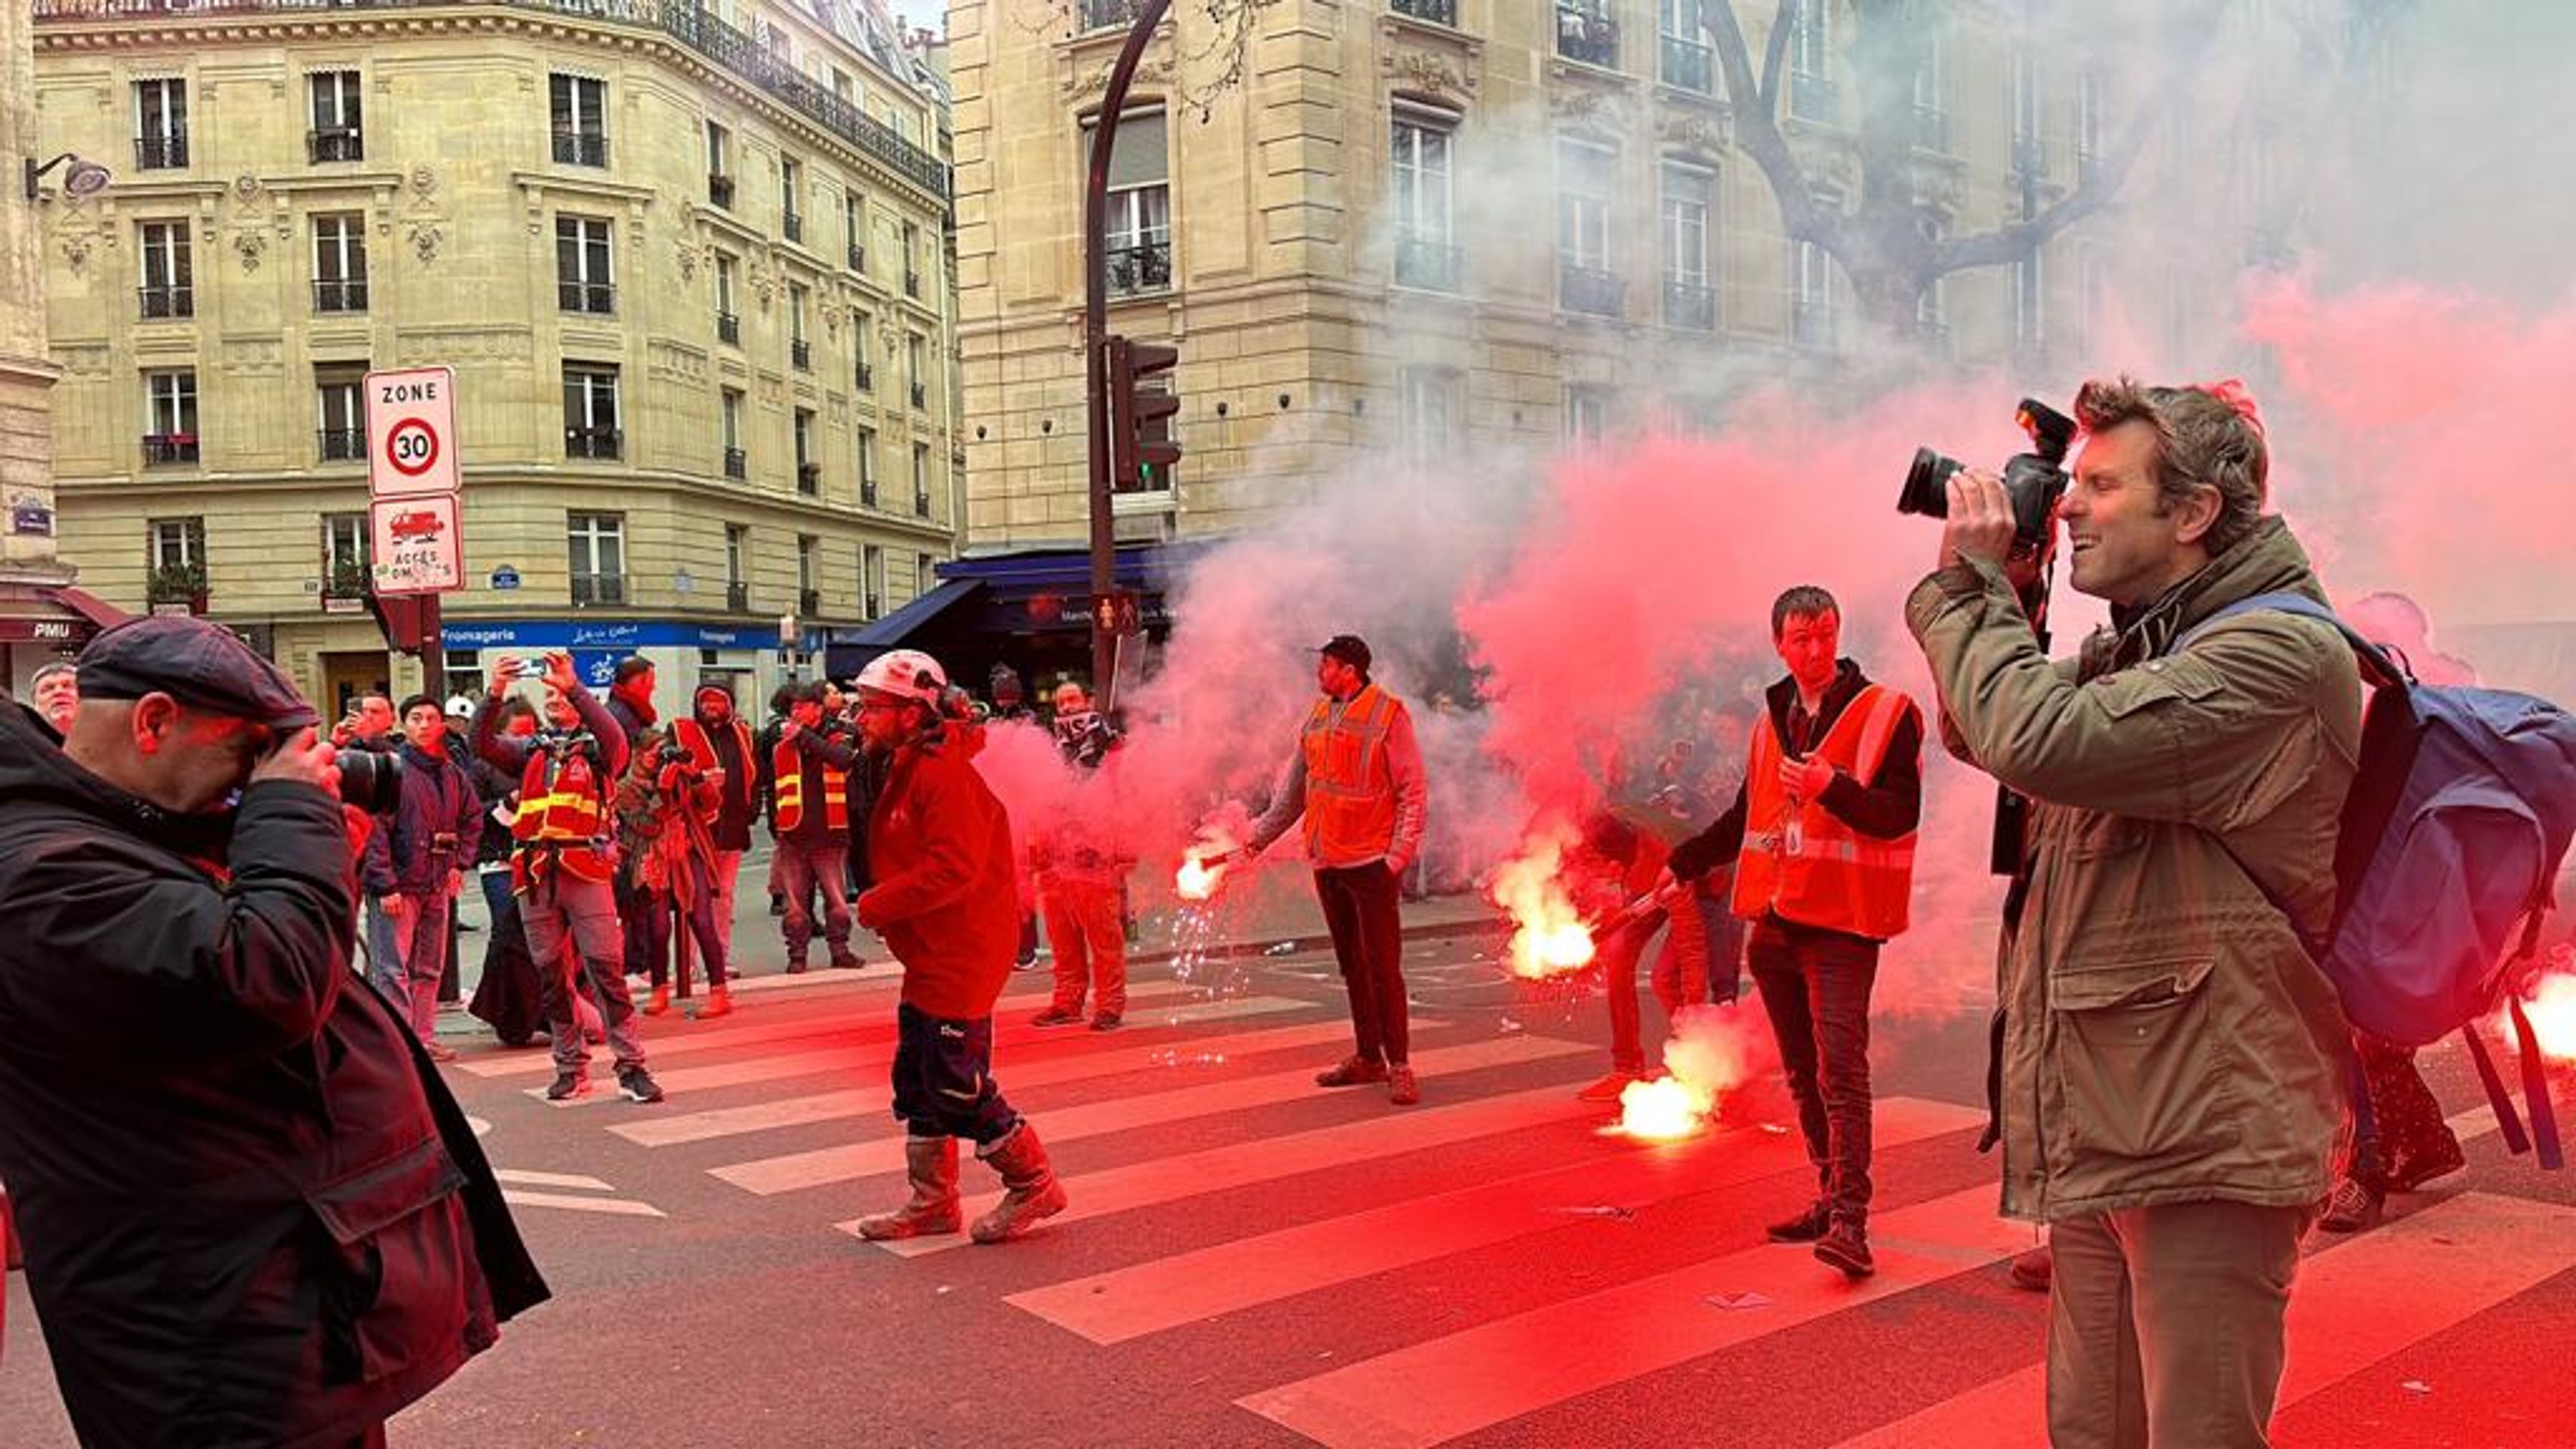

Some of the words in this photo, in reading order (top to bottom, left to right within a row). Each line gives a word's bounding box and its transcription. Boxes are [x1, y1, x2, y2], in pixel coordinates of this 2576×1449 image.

[383, 383, 437, 403] ZONE
[397, 435, 429, 459] 30
[35, 623, 69, 638] PMU
